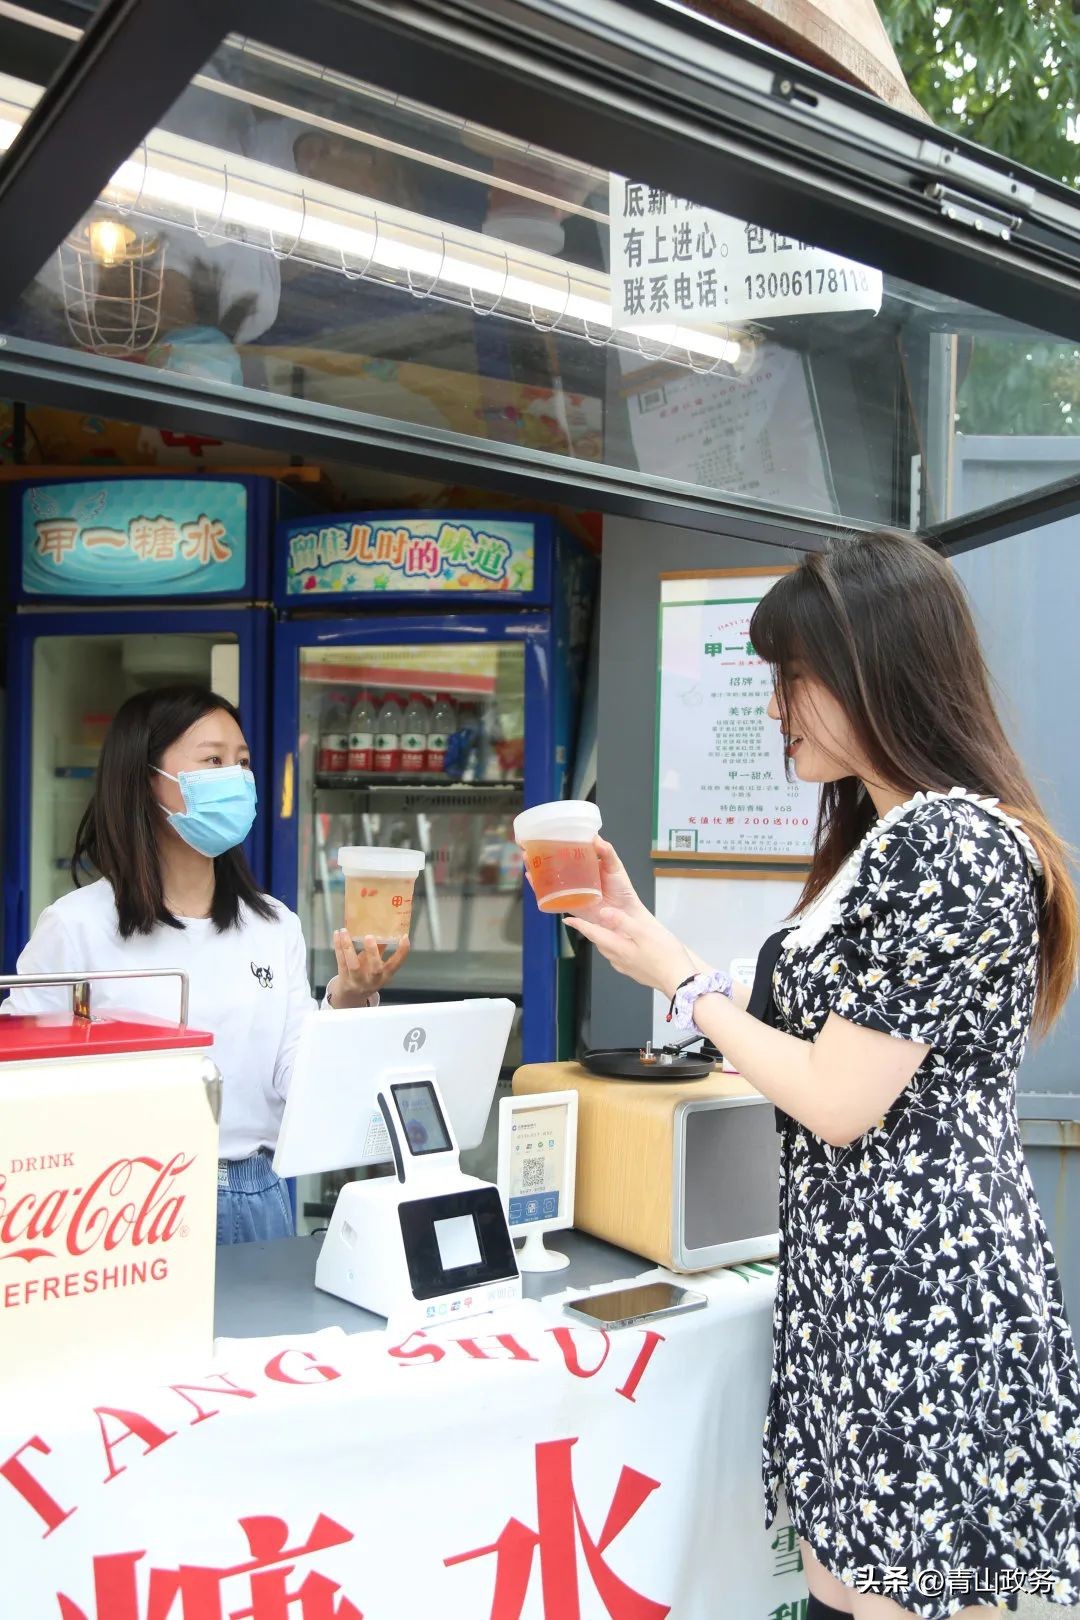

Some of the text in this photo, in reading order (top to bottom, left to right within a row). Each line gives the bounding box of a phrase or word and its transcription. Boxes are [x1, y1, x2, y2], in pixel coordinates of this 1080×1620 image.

[36, 515, 232, 563] 甲一糖水
[290, 523, 511, 579] 留住儿时的味道
[729, 677, 753, 687] 招牌
[728, 771, 774, 780] 甲一甜点
[687, 816, 810, 826] 充值优惠 200送100
[10, 1152, 76, 1173] DRINK
[4, 1258, 169, 1308] EFRESHING
[0, 1326, 667, 1539] TANG SHUI
